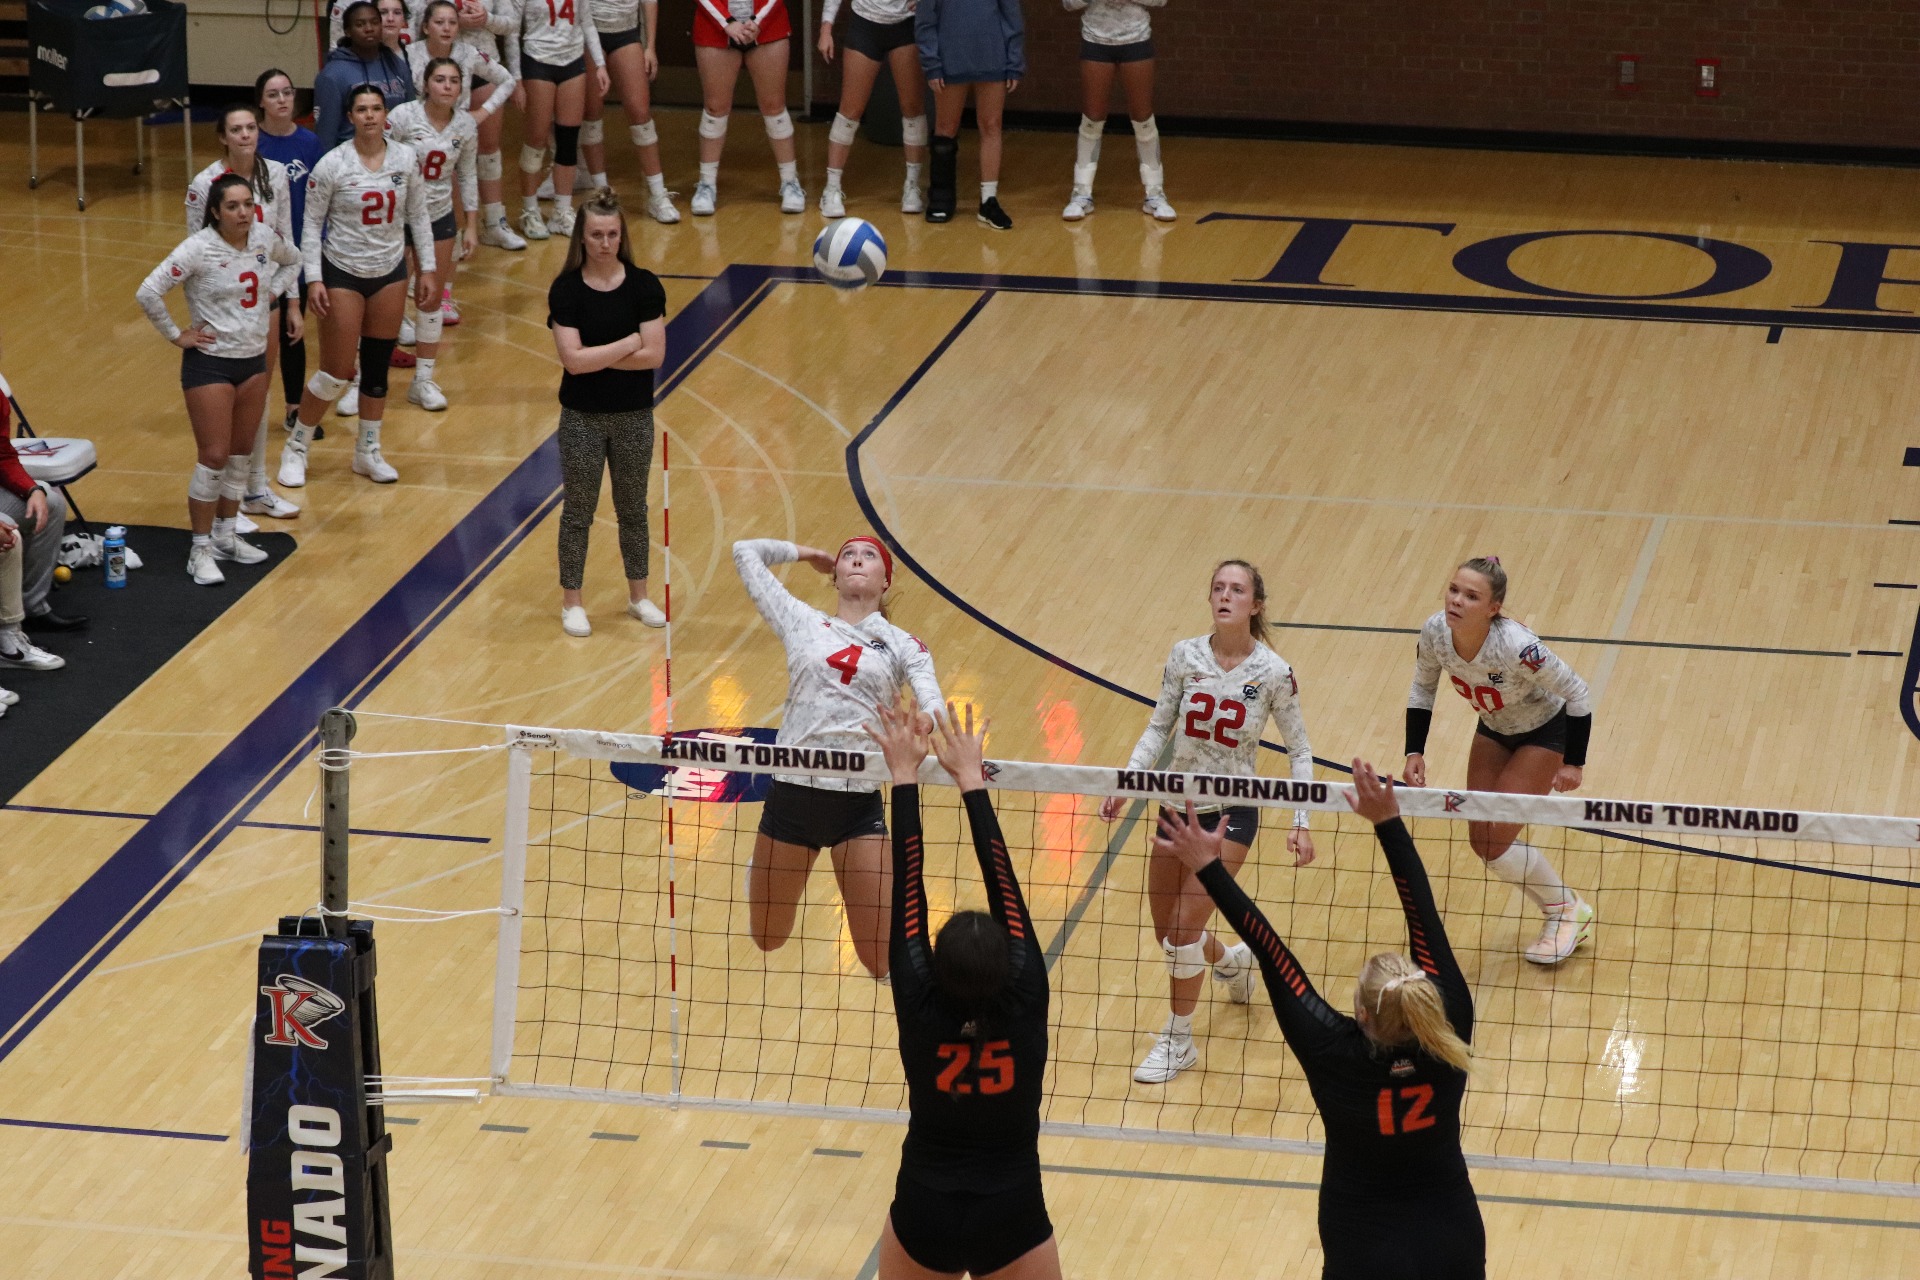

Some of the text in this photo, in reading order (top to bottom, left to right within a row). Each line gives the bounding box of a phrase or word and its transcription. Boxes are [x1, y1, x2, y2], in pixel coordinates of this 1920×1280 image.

[545, 0, 575, 27] 14
[361, 190, 396, 225] 21
[239, 271, 259, 309] 3
[826, 643, 864, 686] 4
[1451, 675, 1504, 714] 20
[1185, 692, 1247, 749] 22
[661, 740, 866, 772] KING TORNADO
[1116, 770, 1328, 804] KING TORNADO
[1584, 800, 1799, 833] KING TORNADO
[261, 984, 328, 1049] K
[936, 1039, 1015, 1095] 25
[1377, 1083, 1436, 1136] 12
